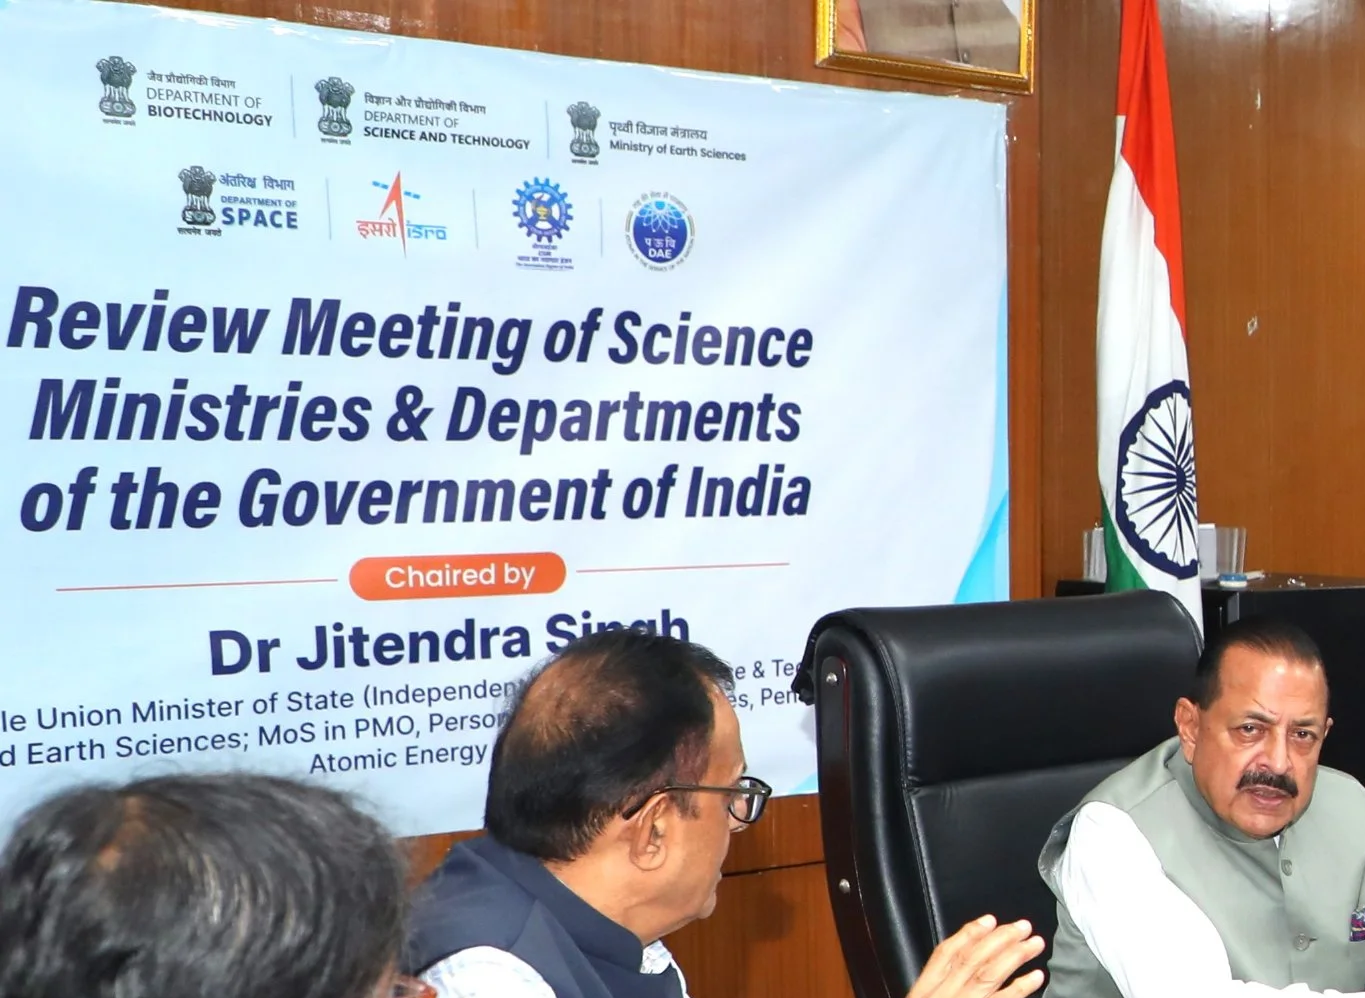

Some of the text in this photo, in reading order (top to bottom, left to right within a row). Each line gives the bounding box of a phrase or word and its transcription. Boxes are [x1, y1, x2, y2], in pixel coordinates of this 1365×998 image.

[147, 70, 163, 83] जैव
[210, 76, 235, 89] विभाग
[147, 87, 262, 109] DEPARTMENT OF
[364, 92, 392, 106] विज्ञान
[395, 95, 412, 108] और
[459, 101, 486, 114] विभाग
[148, 105, 273, 127] BIOTECHNOLOGY
[364, 111, 459, 128] DEPARTMENT OF
[364, 127, 530, 150] SCIENCE AND TECHNOLOGY
[609, 120, 633, 136] पृथ्वी
[670, 126, 707, 140] मंत्रालय
[610, 140, 746, 161] Ministry of Earth Sciences
[219, 173, 295, 191] अंतरिक्ष विभाग
[221, 195, 297, 208] DEPARTMENT OF
[222, 207, 298, 229] SPACE
[355, 218, 396, 239] इसरो
[648, 248, 672, 258] DAE
[6, 286, 814, 375] Review Meeting of Science
[29, 379, 801, 455] Ministries & Departments
[20, 465, 811, 533] of the Government of India
[385, 562, 536, 591] Chaired by
[209, 629, 281, 675] Dr
[296, 618, 531, 671] Jitendra
[37, 705, 121, 730] Union
[132, 698, 244, 724] Minister
[252, 692, 278, 715] of
[286, 690, 354, 713] State
[363, 679, 523, 709] (Independen
[752, 660, 765, 679] &
[28, 739, 105, 765] Earth
[116, 728, 249, 756] Sciences;
[258, 722, 316, 748] MoS
[325, 719, 347, 741] in
[355, 714, 420, 739] PMO,
[309, 744, 488, 774] Atomic Energy
